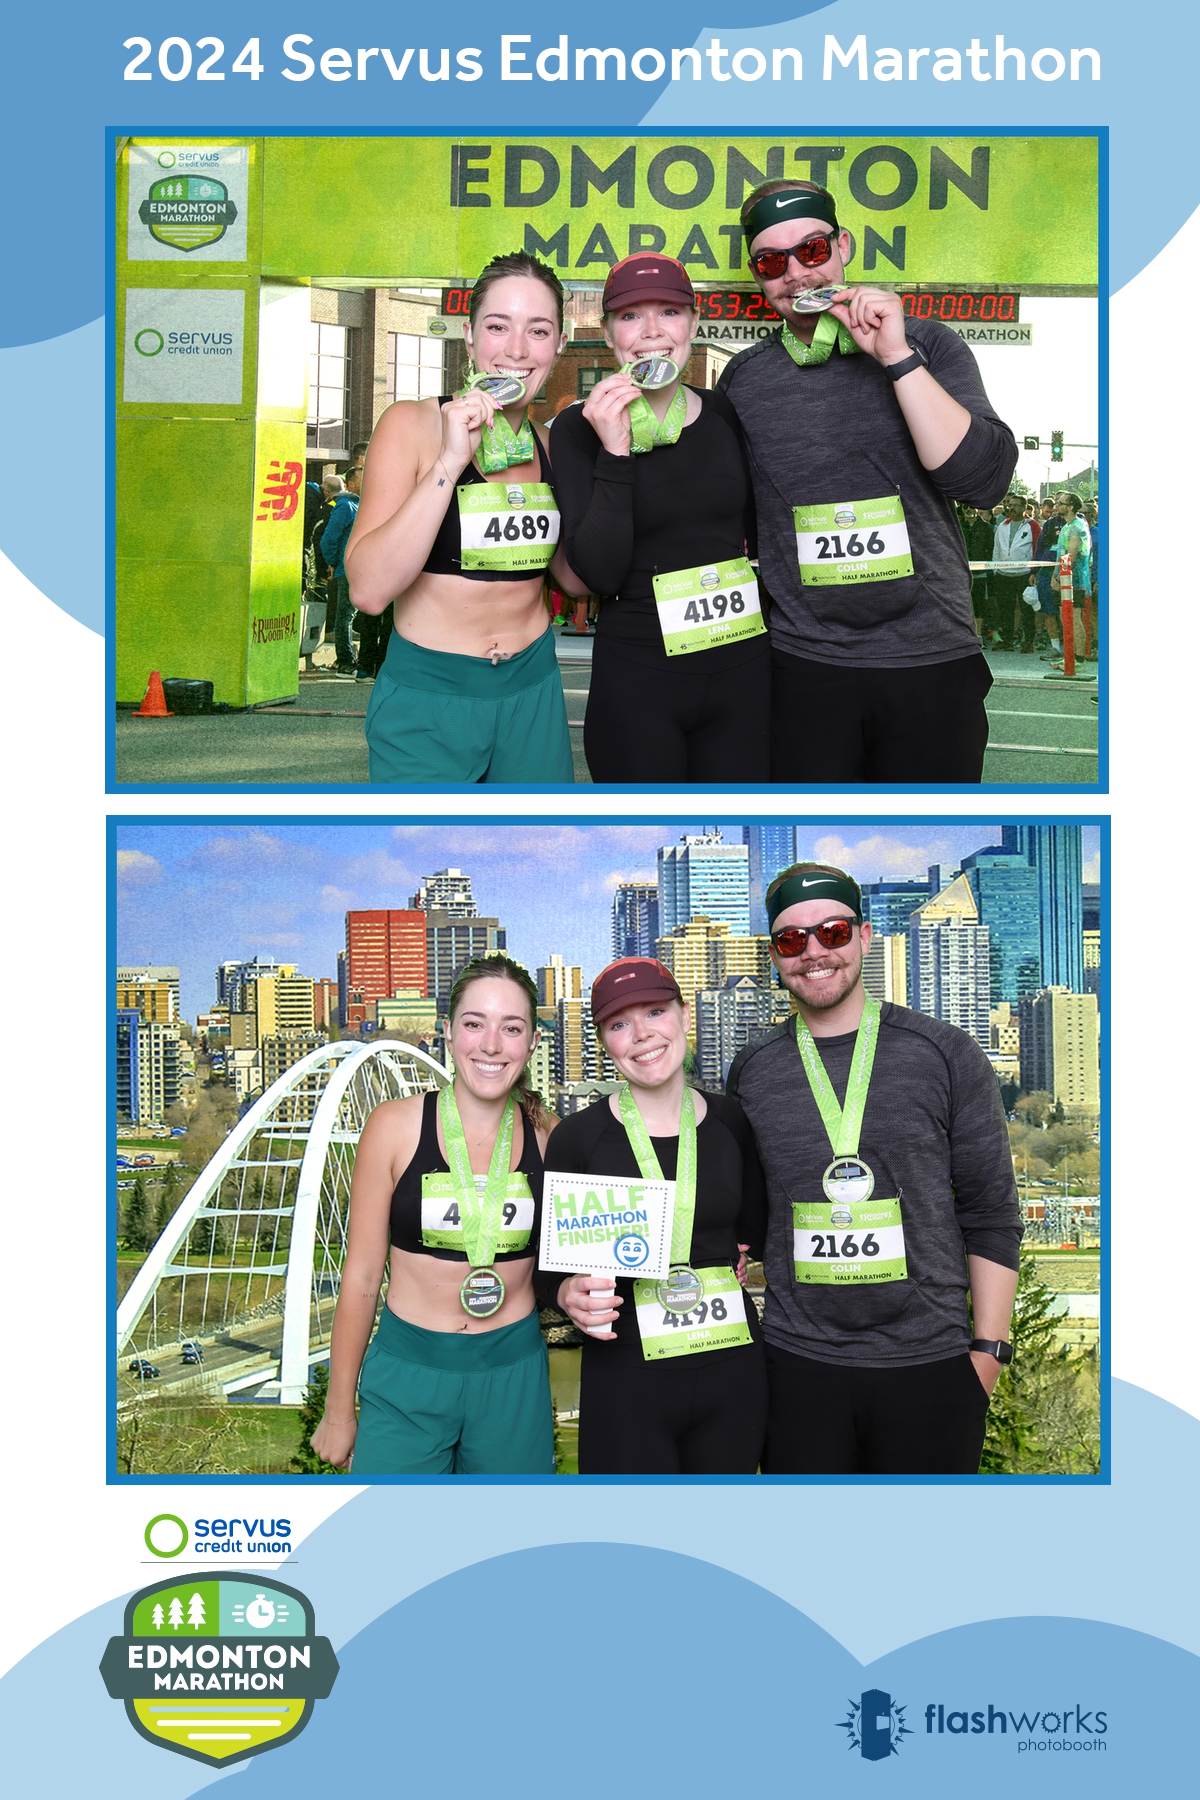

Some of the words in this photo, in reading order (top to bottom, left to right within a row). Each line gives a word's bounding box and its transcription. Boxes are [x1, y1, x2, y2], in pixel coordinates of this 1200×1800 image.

[179, 152, 220, 161] servus
[450, 145, 990, 211] EDMONTON
[149, 203, 227, 214] EDMONTON
[160, 214, 215, 222] MARATHON
[523, 223, 907, 271] MARATN
[168, 332, 233, 345] servus
[958, 329, 1031, 341] ARATHON
[168, 345, 200, 355] credit
[203, 347, 233, 355] union
[484, 515, 550, 542] 4689
[815, 531, 885, 559] 2166
[837, 562, 869, 573] COLIN
[860, 569, 899, 579] MARATHON
[684, 590, 745, 623] 4198
[707, 623, 731, 635] LENA
[710, 635, 725, 644] HALF
[726, 627, 756, 640] MARATHON
[553, 1185, 645, 1218] HALF
[443, 1203, 517, 1225] 49
[556, 1209, 647, 1231] MARATHON
[557, 1223, 649, 1247] FINISHER!
[810, 1233, 880, 1258] 2166
[830, 1264, 861, 1273] COLIN
[853, 1272, 892, 1280] MARATHON
[686, 1329, 712, 1341] LENA
[707, 1336, 740, 1347] MARATHON
